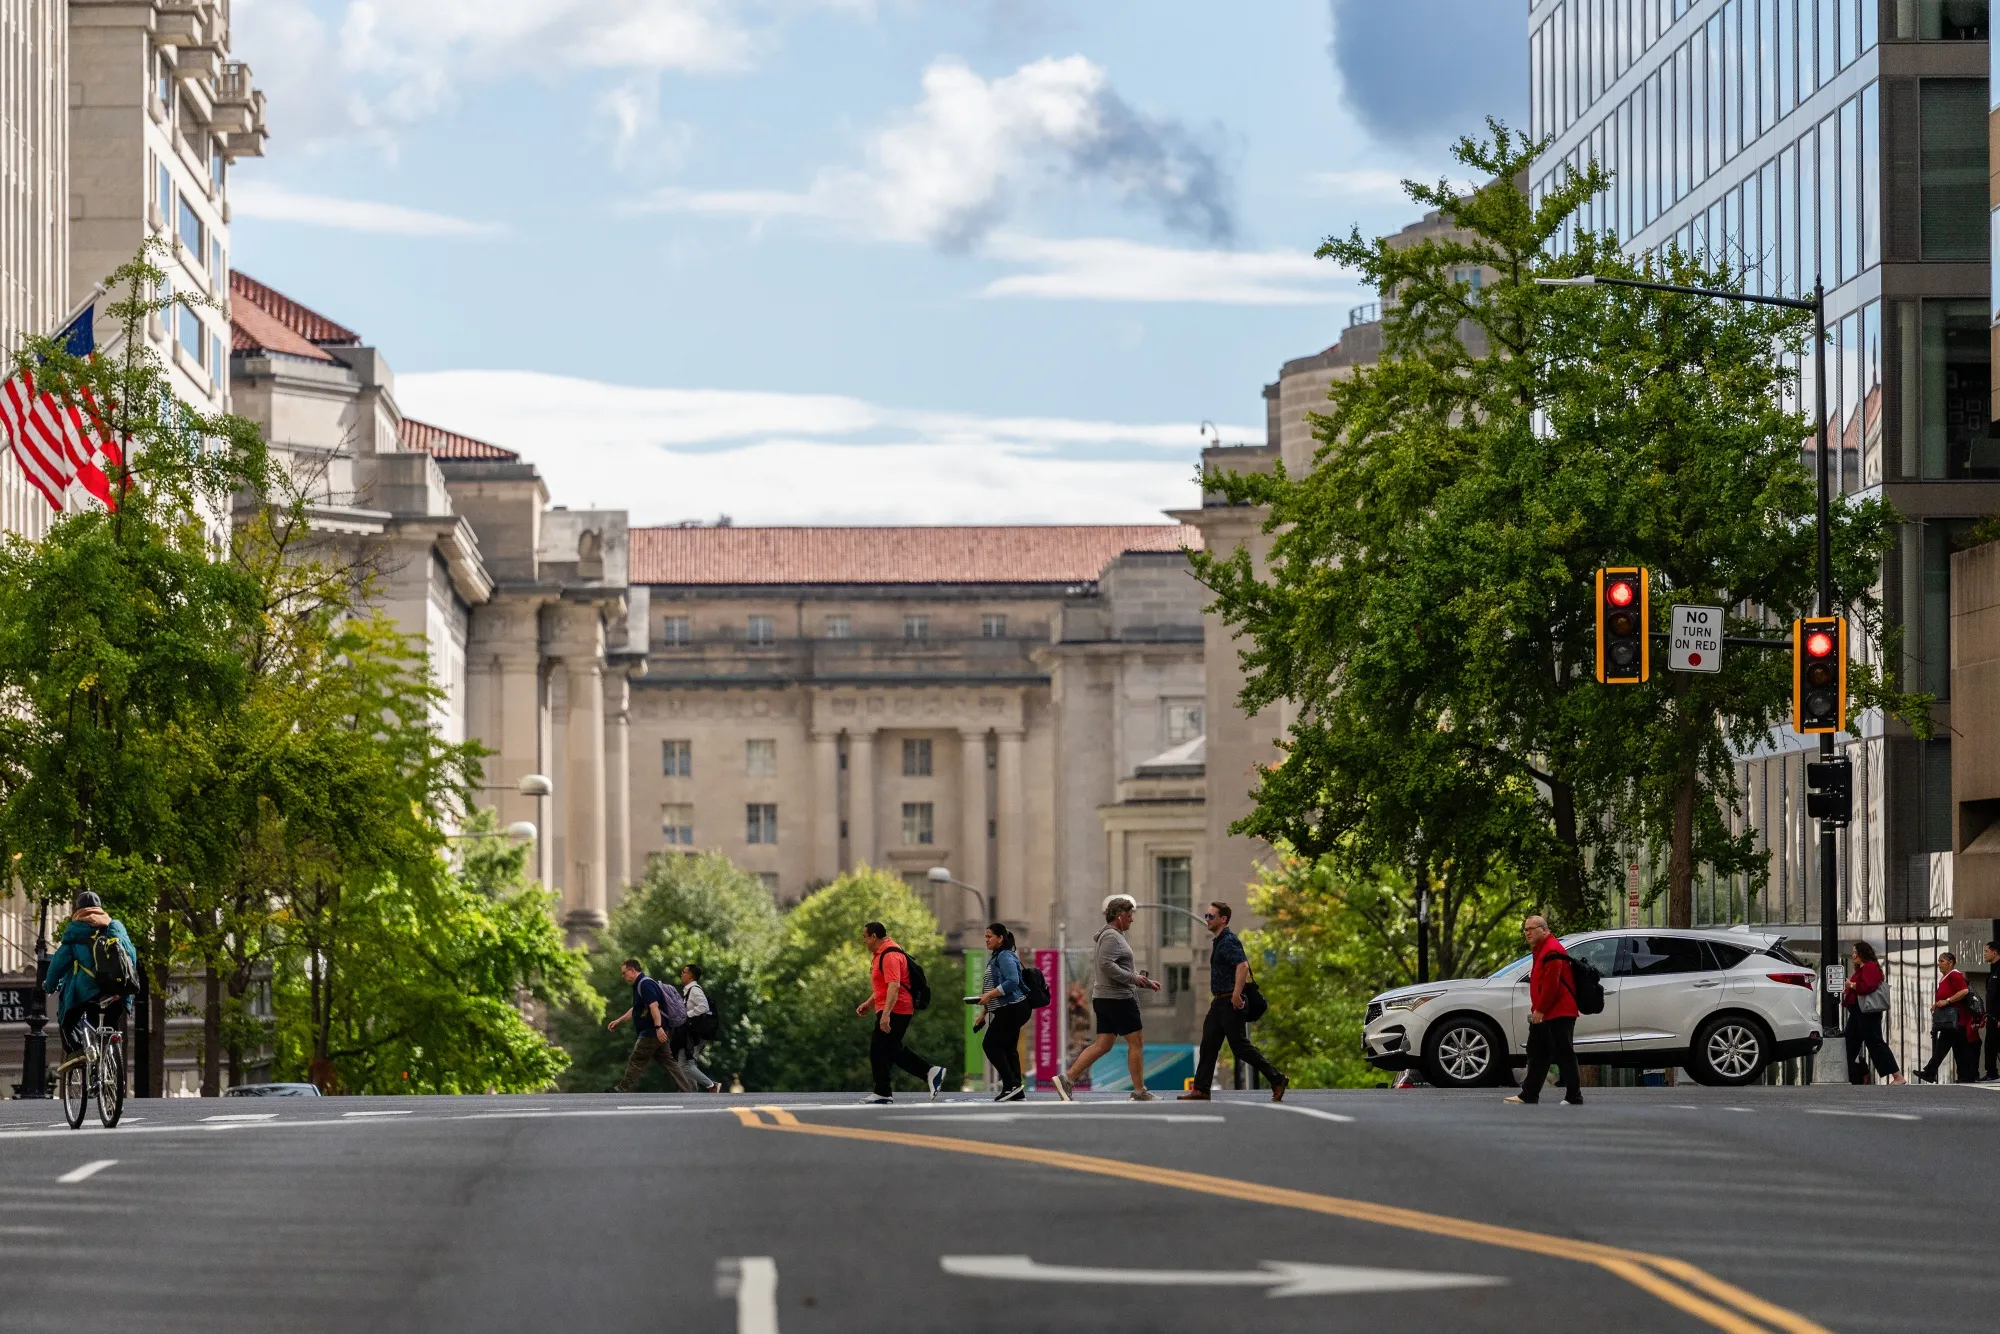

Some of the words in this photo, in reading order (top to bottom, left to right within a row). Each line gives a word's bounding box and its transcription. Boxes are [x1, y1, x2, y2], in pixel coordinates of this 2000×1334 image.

[1686, 611, 1708, 624] NO
[1682, 626, 1712, 637] TURN
[1675, 639, 1690, 649] ON
[1695, 640, 1717, 651] RED
[0, 1006, 25, 1021] RE
